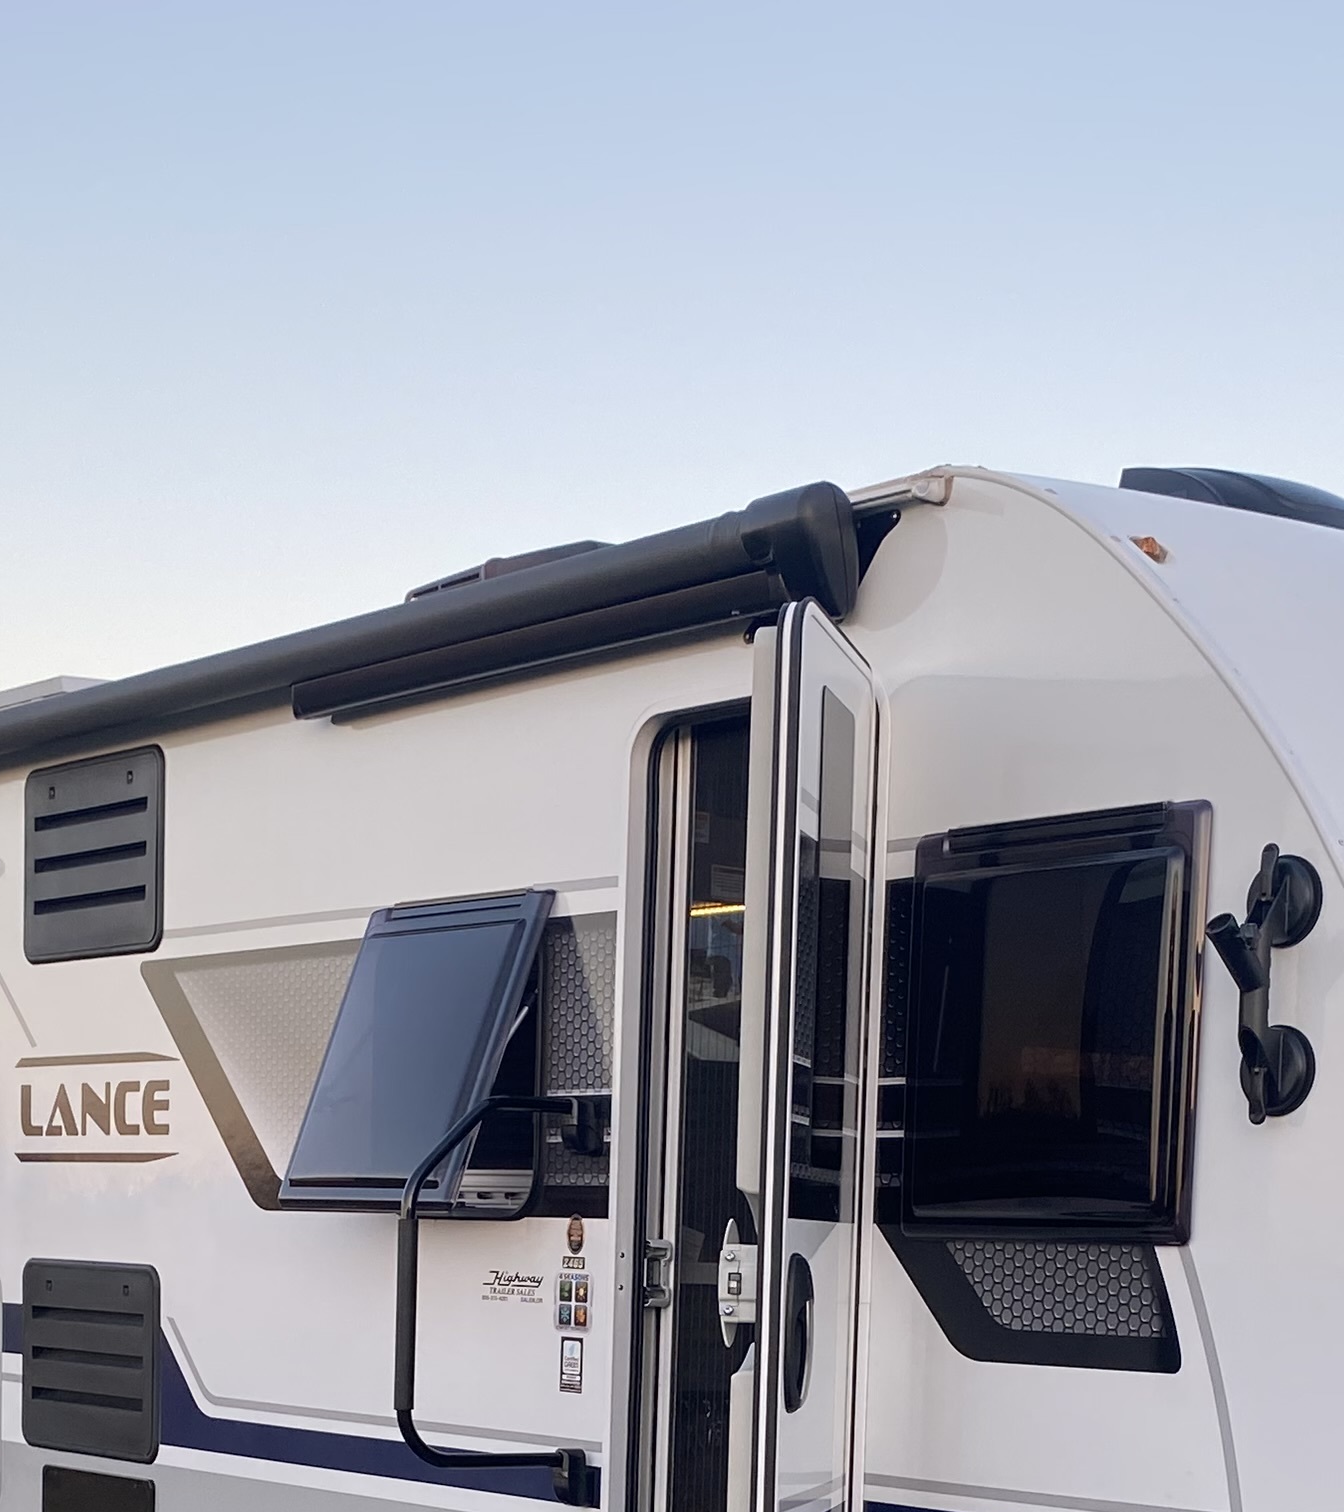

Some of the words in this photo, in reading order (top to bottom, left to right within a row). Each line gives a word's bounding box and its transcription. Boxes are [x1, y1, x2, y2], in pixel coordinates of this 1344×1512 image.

[20, 1079, 170, 1136] LANCE
[483, 1270, 544, 1288] Highway
[490, 1287, 515, 1295] TRAILER
